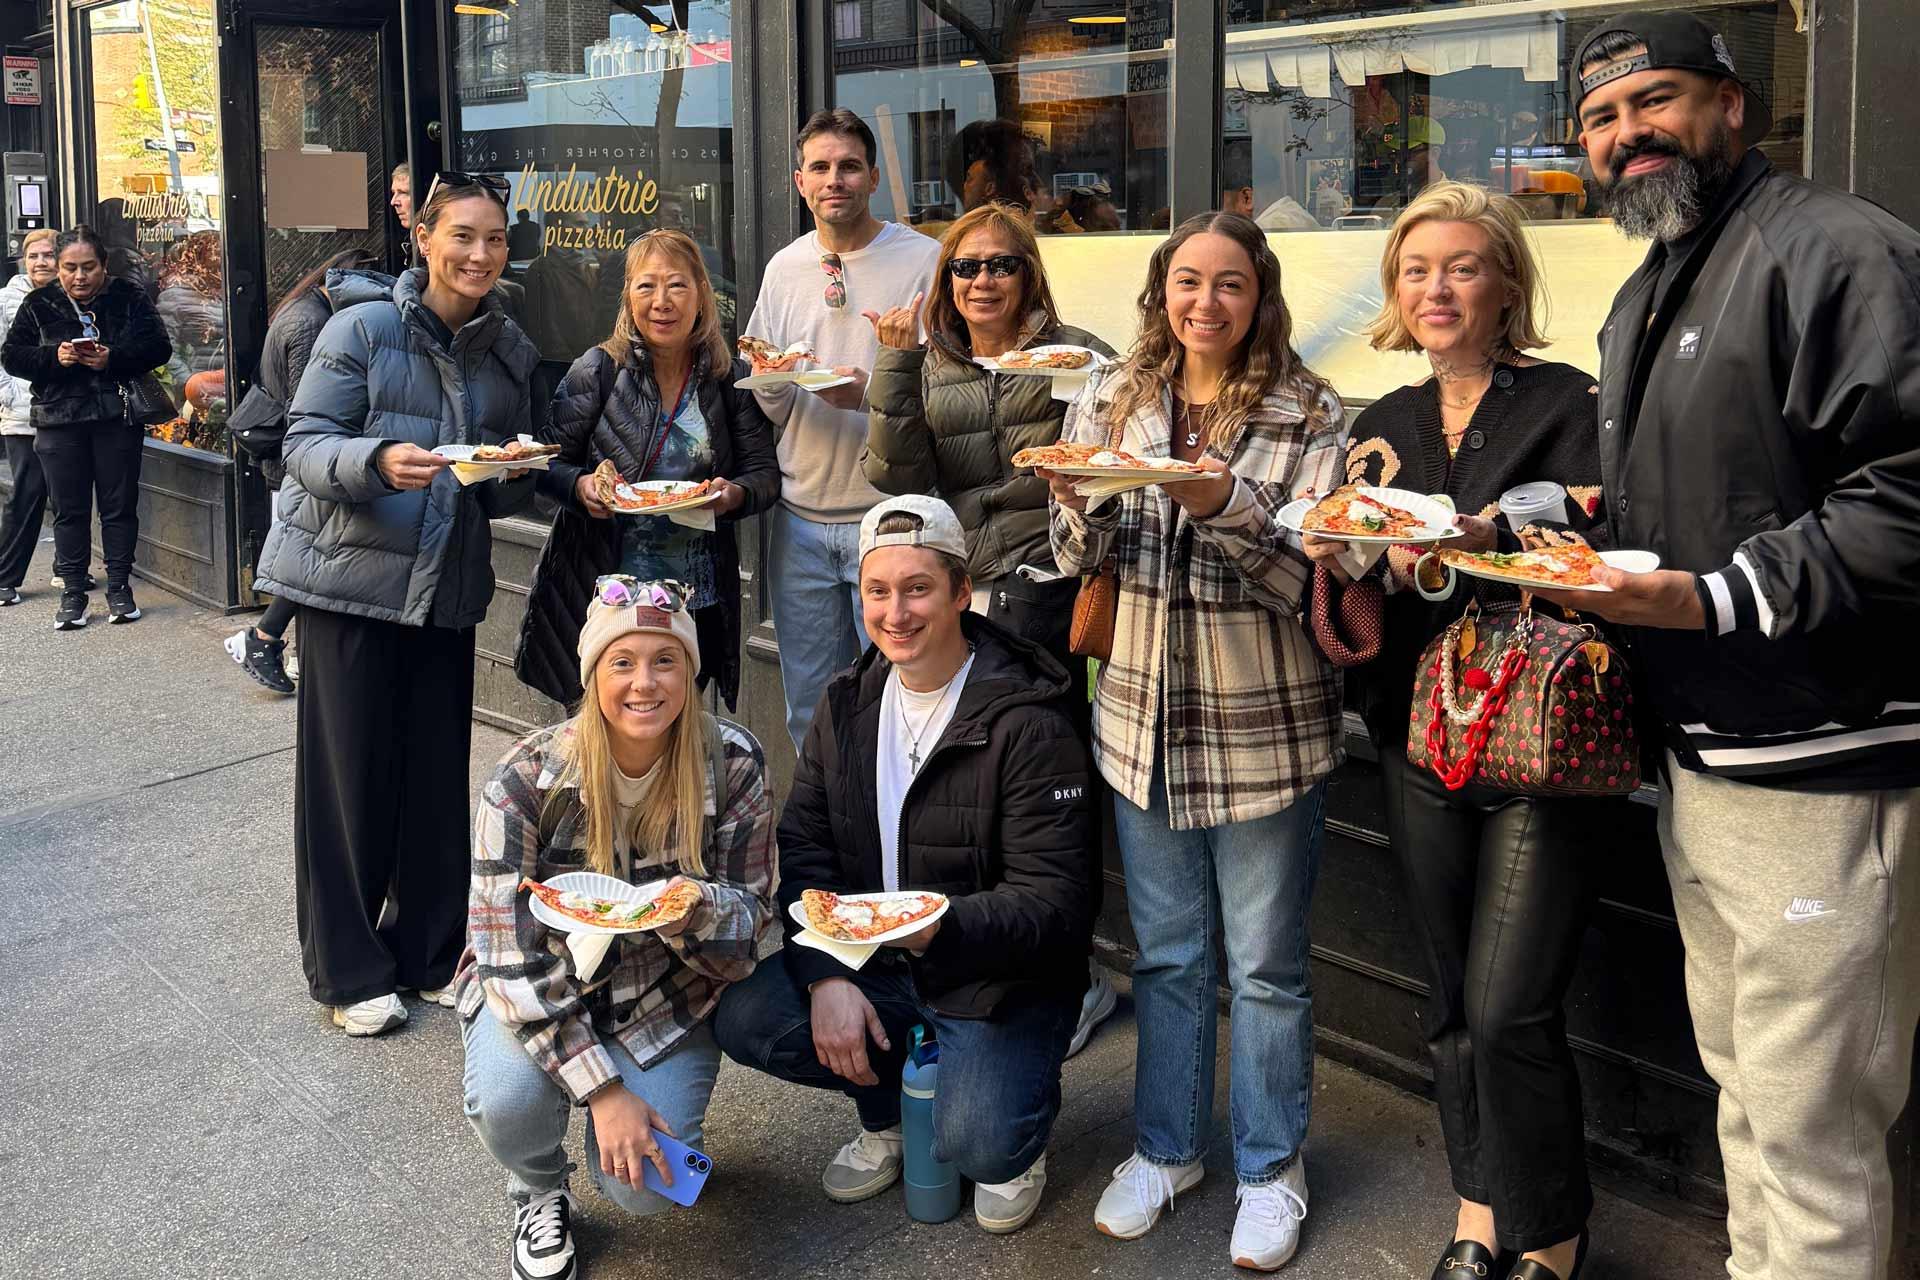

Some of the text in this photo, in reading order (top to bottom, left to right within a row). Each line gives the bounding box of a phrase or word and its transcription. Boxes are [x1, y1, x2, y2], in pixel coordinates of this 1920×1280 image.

[136, 222, 175, 243] pizzeria
[543, 218, 626, 257] pizzeria
[1054, 787, 1082, 800] DKNY
[1791, 897, 1825, 912] NIKE
